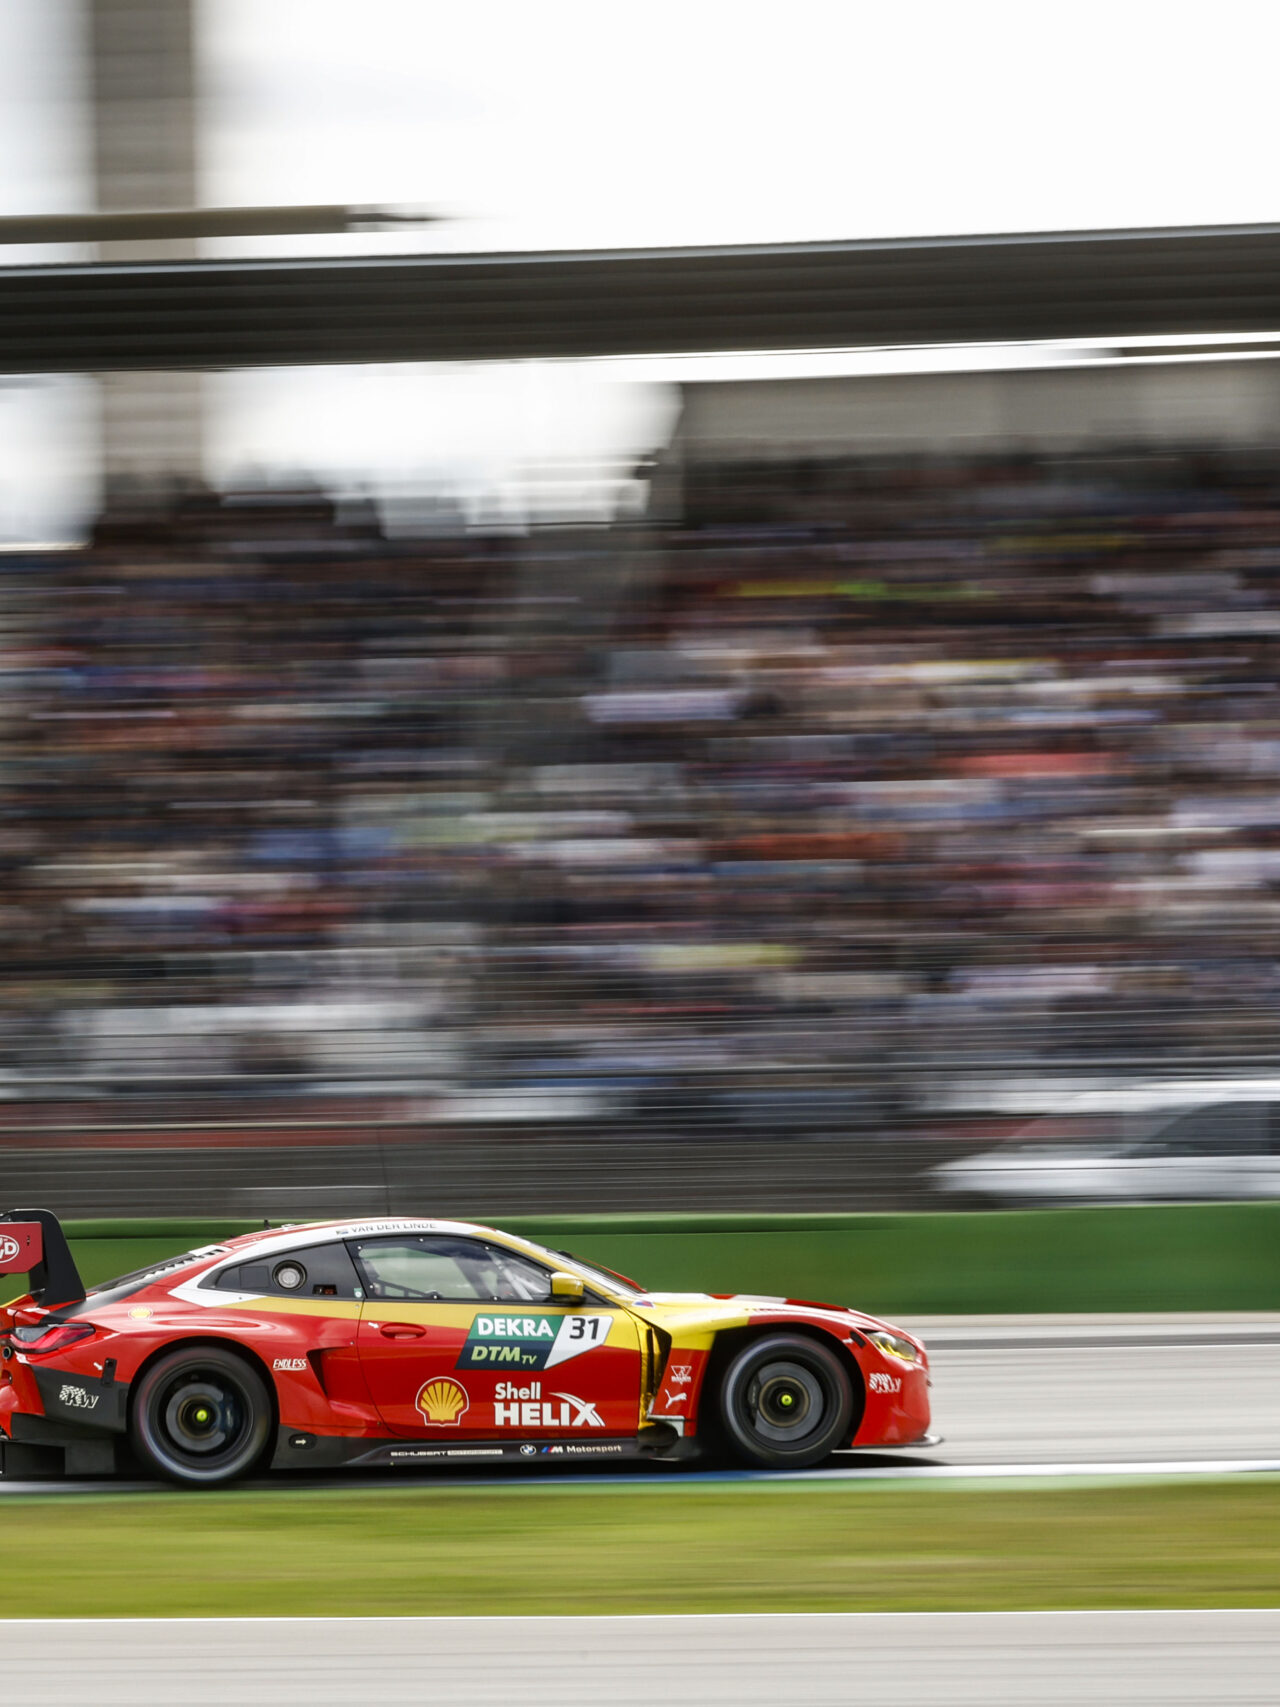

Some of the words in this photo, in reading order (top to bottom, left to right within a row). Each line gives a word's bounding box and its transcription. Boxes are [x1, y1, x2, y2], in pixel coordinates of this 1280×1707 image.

[477, 1317, 555, 1338] DEKRA
[569, 1317, 600, 1340] 31
[272, 1358, 308, 1369] ENDLESS
[471, 1345, 521, 1362] DTM
[521, 1354, 538, 1365] TV
[494, 1381, 541, 1400] Shell
[493, 1398, 606, 1427] HELIX
[566, 1444, 622, 1454] Motorsport
